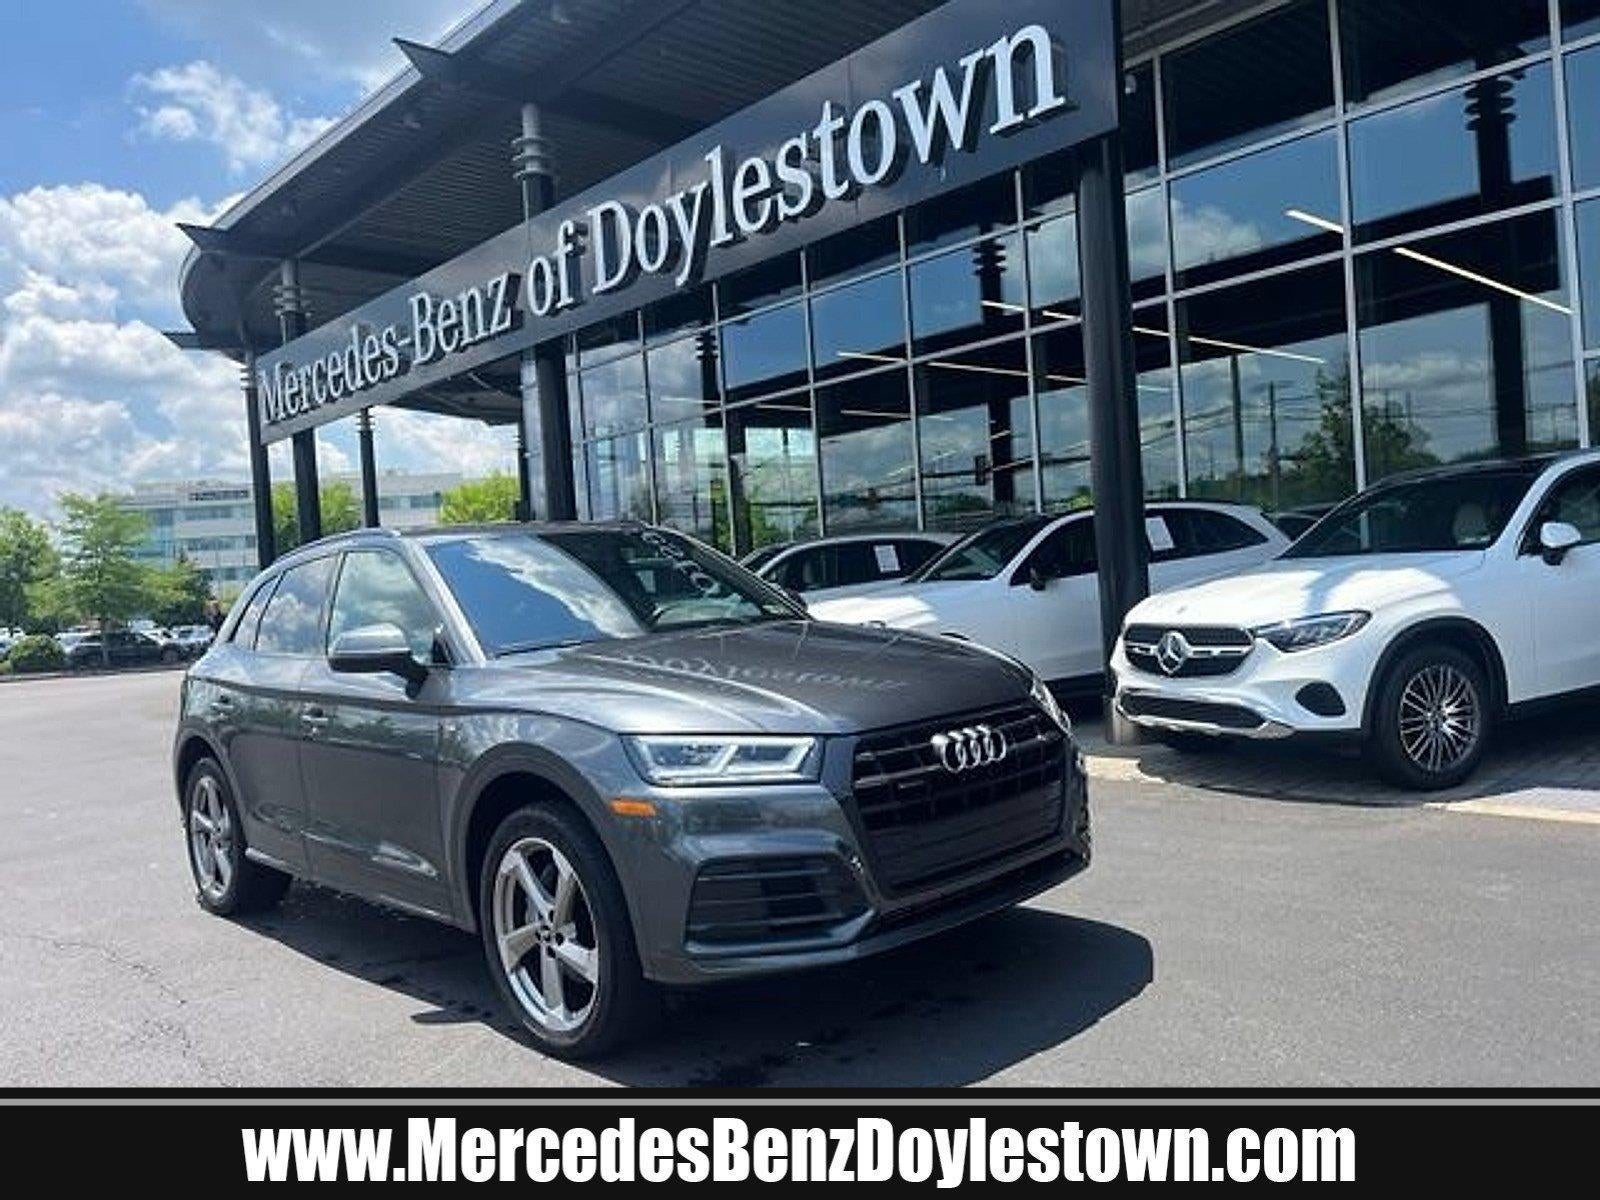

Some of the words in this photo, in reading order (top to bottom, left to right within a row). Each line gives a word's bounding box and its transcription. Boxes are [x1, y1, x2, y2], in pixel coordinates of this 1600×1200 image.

[258, 271, 514, 424] Mercedes-Benz
[526, 219, 580, 315] of
[588, 22, 1067, 292] Doylestown
